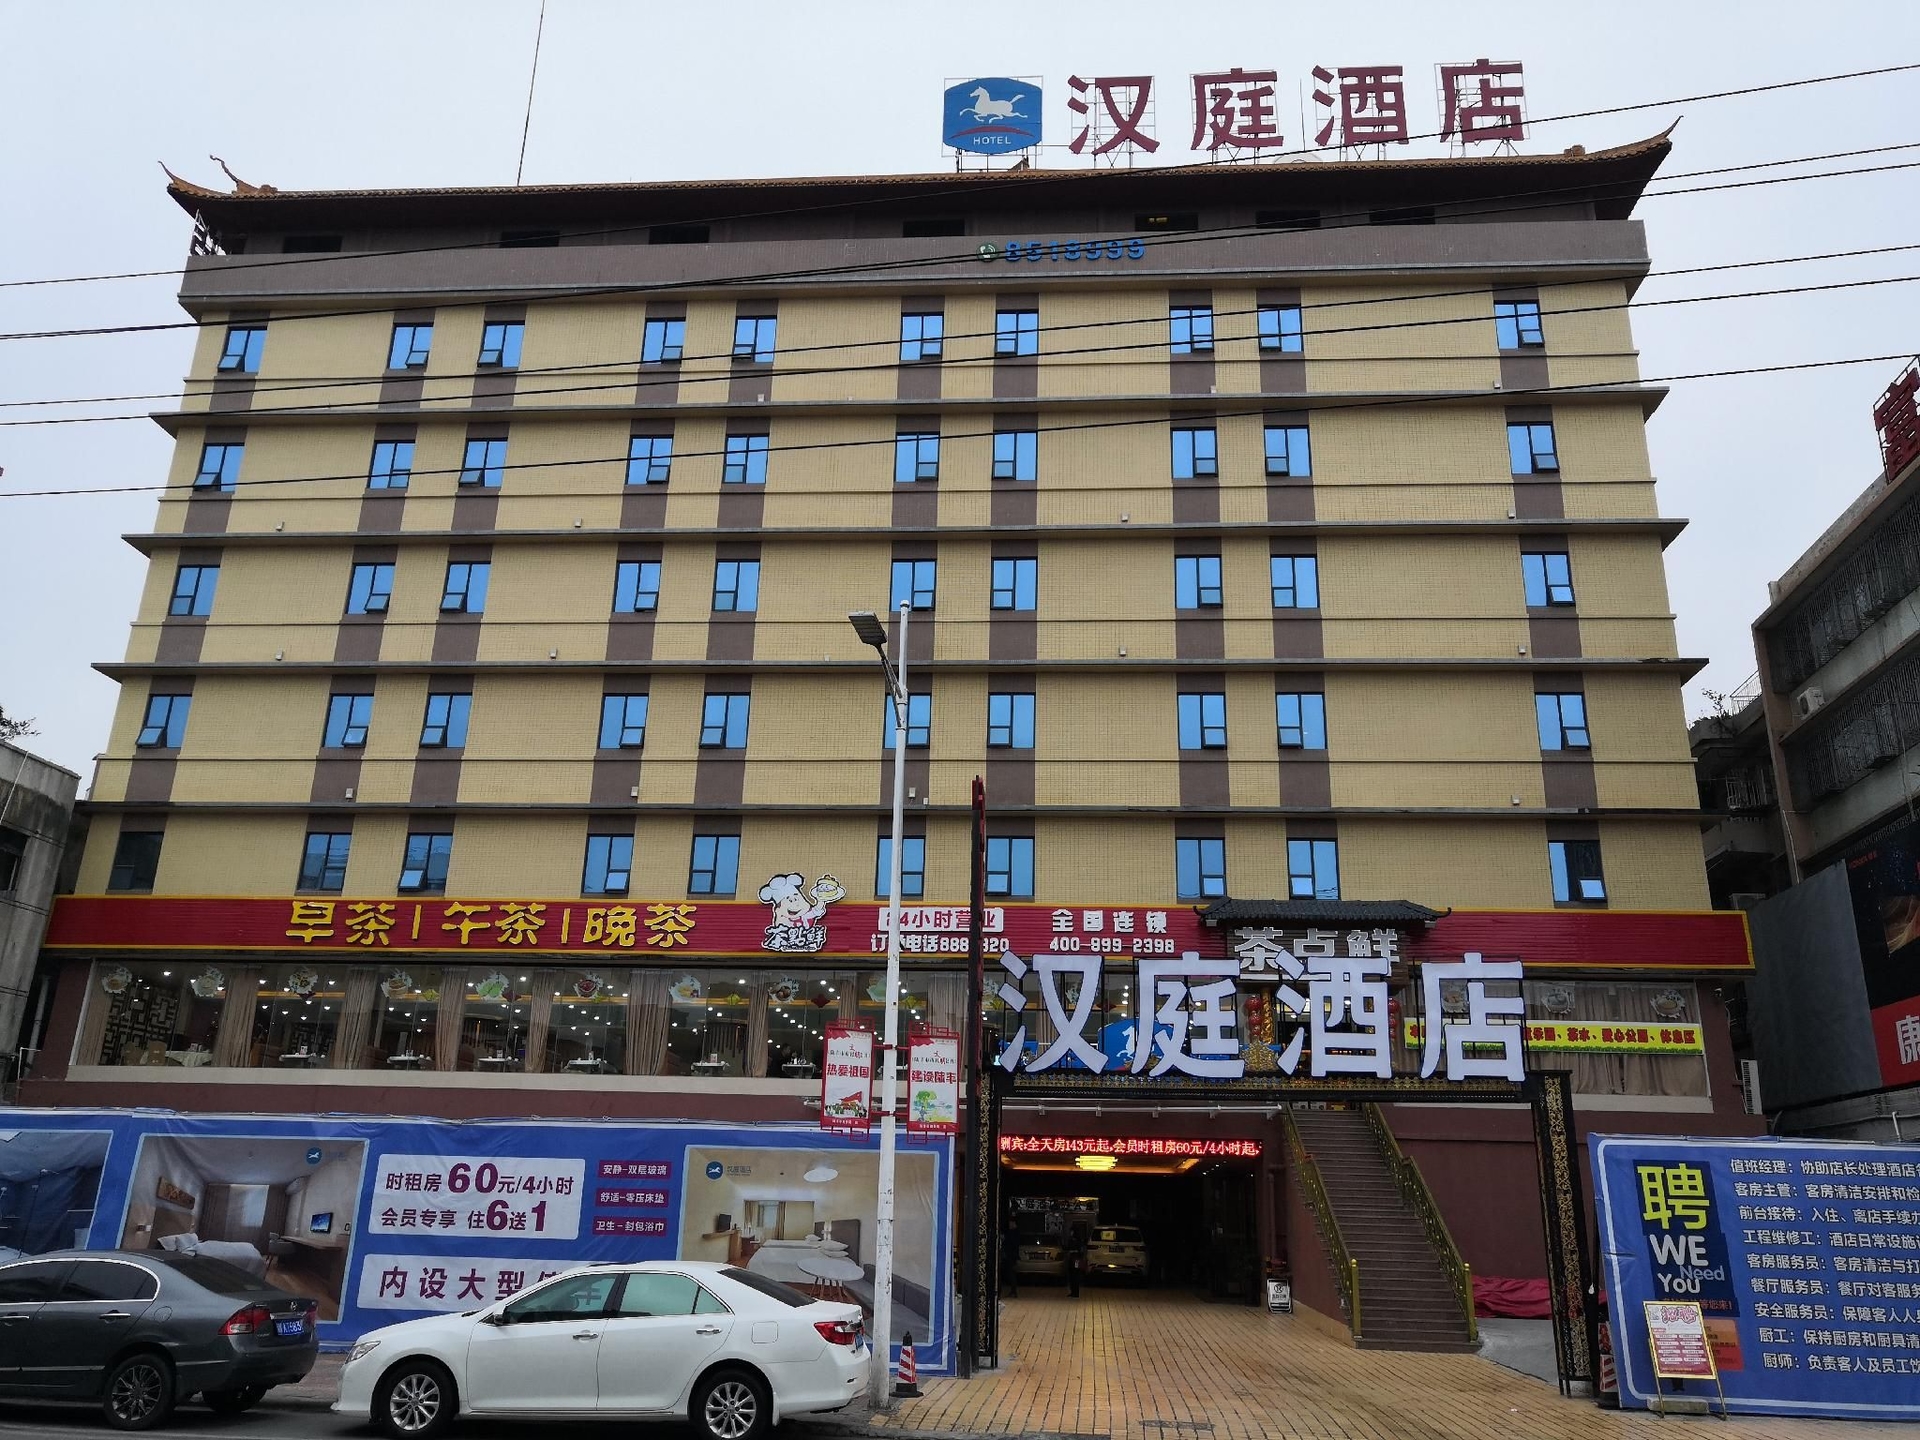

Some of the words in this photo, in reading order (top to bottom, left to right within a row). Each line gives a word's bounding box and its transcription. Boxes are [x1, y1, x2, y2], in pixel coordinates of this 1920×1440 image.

[1068, 59, 1525, 155] 汉庭酒店
[973, 136, 1012, 145] HOTEL
[1004, 239, 1146, 262] 8518999
[285, 901, 396, 945] 早茶
[441, 902, 546, 945] 午茶
[584, 904, 697, 947] 晚茶
[1052, 909, 1167, 933] 全国连锁
[1000, 951, 1525, 1082] 汉庭酒店
[826, 1063, 870, 1078] 热爱祖国
[911, 1070, 957, 1084] 建设陆丰
[385, 1162, 575, 1195] 时租房60元/4小时
[1637, 1163, 1710, 1230] 聘
[380, 1209, 457, 1230] 会员专享
[467, 1199, 547, 1233] 住6送1
[1649, 1234, 1709, 1267] WE
[1680, 1264, 1725, 1282] Need
